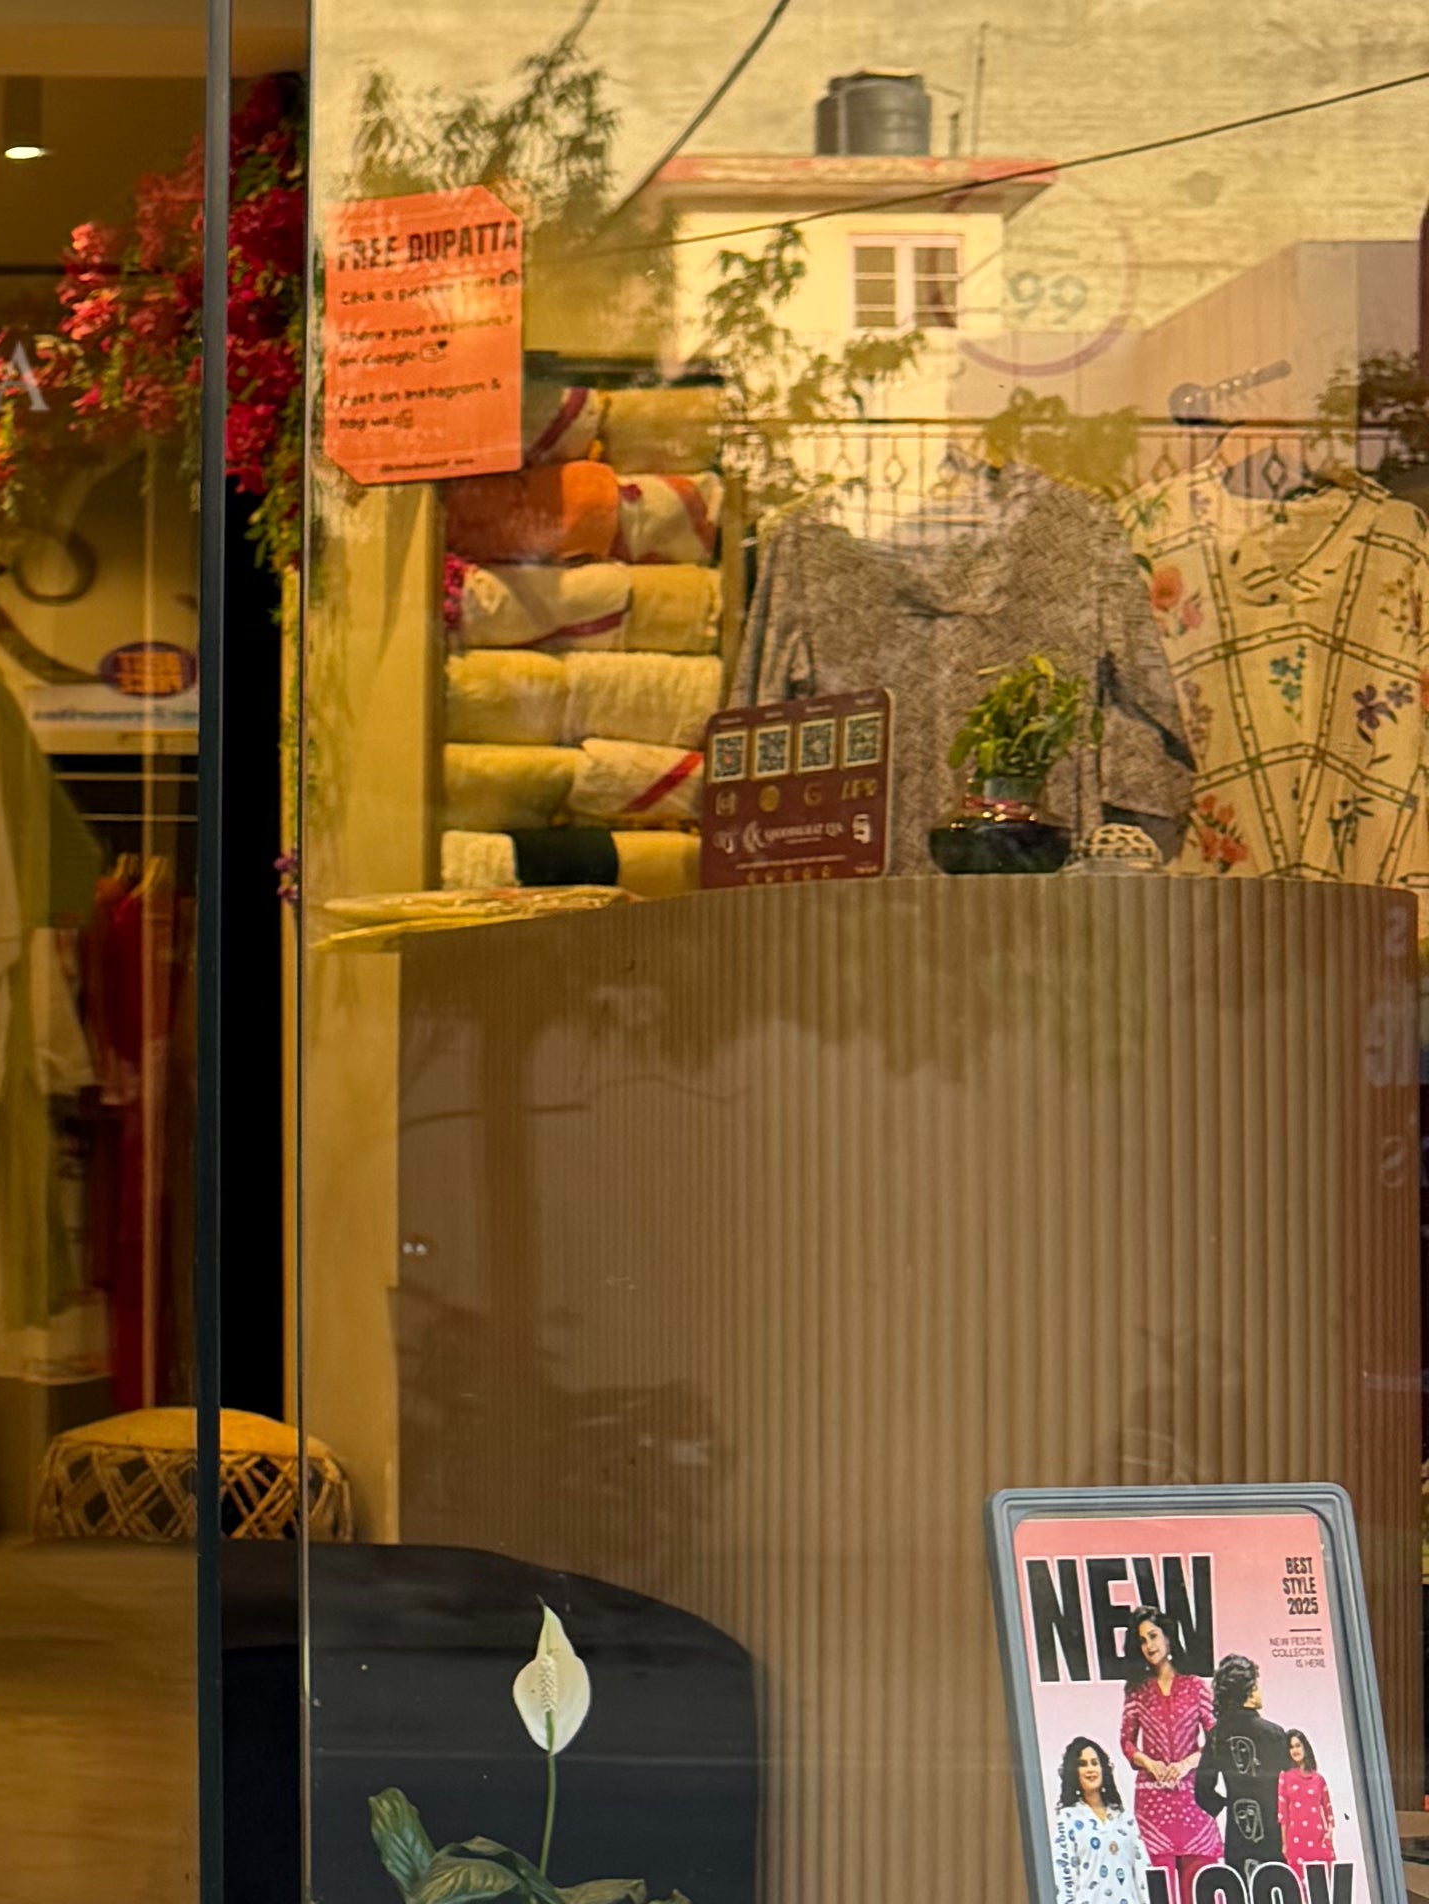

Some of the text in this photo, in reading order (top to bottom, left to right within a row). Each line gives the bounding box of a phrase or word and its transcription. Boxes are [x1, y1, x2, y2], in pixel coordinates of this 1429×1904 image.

[407, 221, 518, 264] DUPATTA
[1285, 1556, 1313, 1575] BEST
[1282, 1576, 1317, 1595] STYLE
[1287, 1597, 1319, 1615] 2025
[1024, 1555, 1216, 1682] NEW
